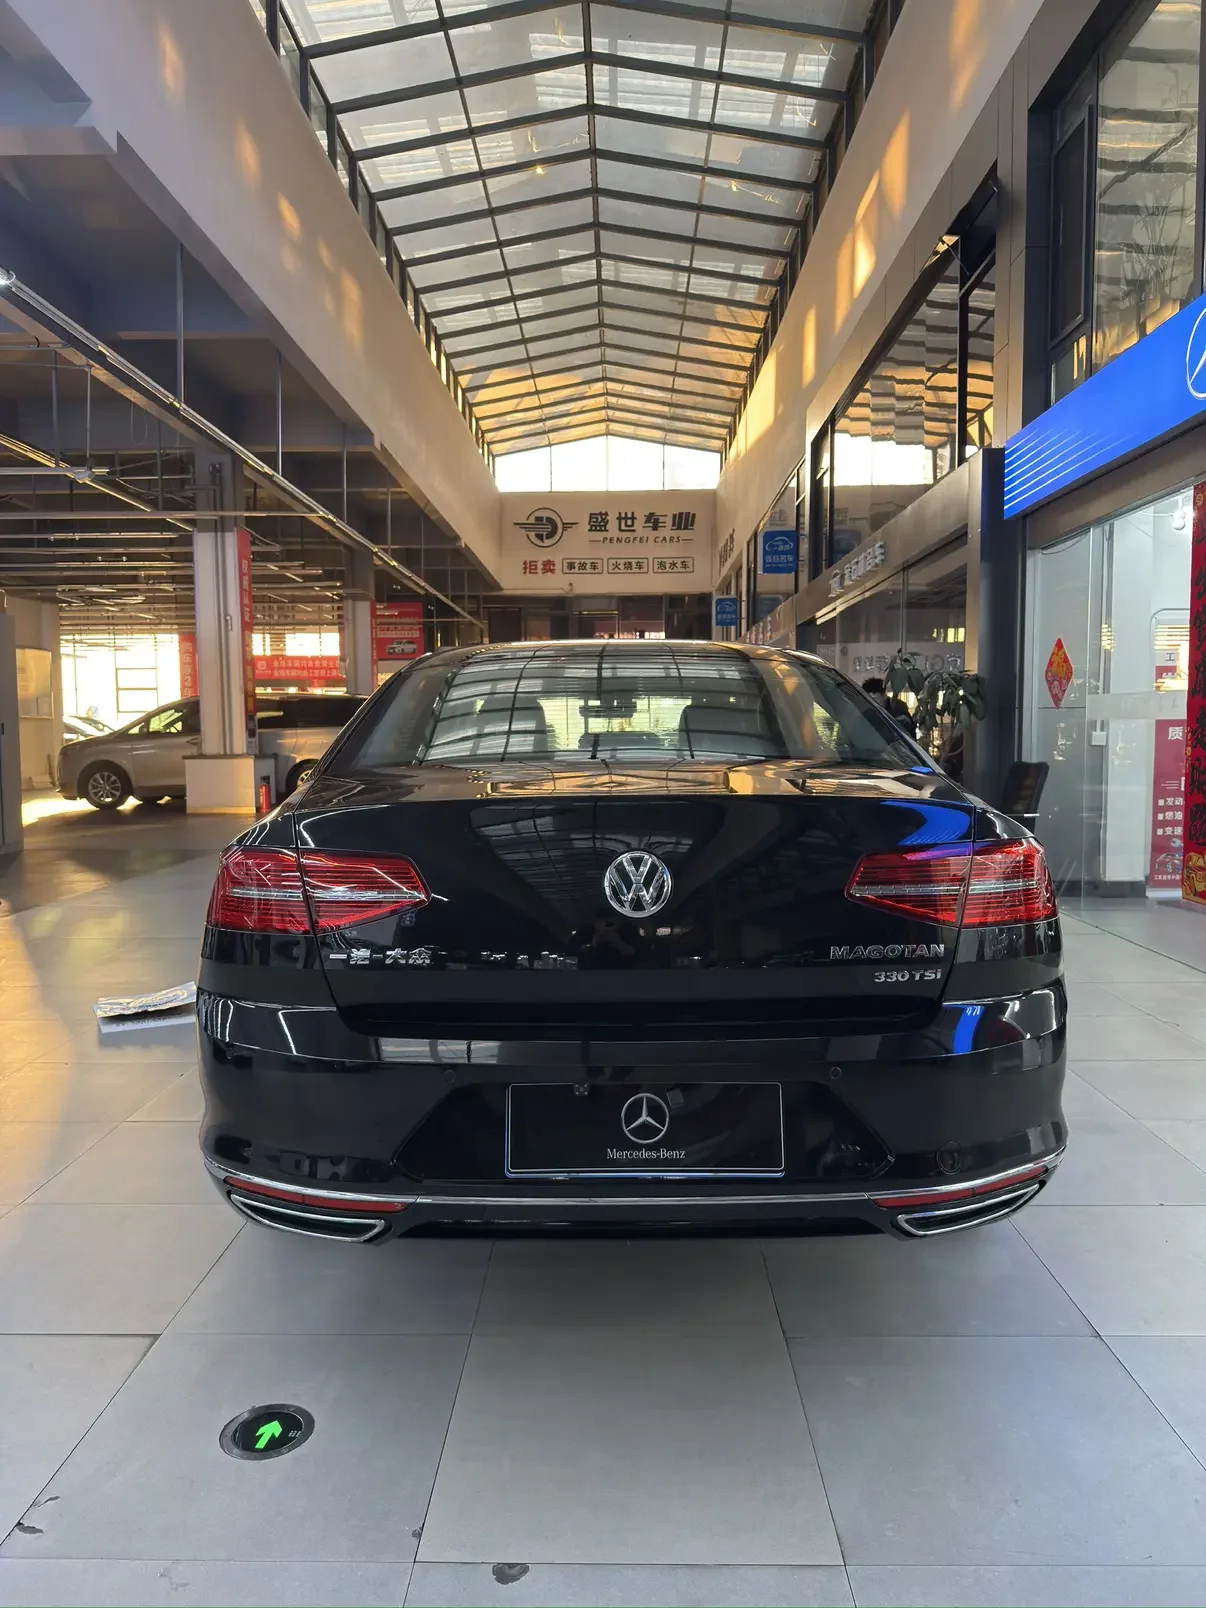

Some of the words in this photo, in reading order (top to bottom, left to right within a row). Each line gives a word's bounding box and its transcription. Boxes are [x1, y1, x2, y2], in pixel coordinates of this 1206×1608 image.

[587, 511, 697, 533] 盛世车业
[601, 536, 649, 544] PENGFEI
[653, 536, 682, 544] CARS
[522, 560, 556, 575] 拒卖
[566, 561, 600, 571] 事故车
[611, 561, 645, 571] 火烧车
[656, 560, 691, 570] 泡水车
[829, 944, 945, 960] MAGOTAN
[874, 970, 910, 983] 330
[606, 1148, 686, 1159] Mercedes-Benz
